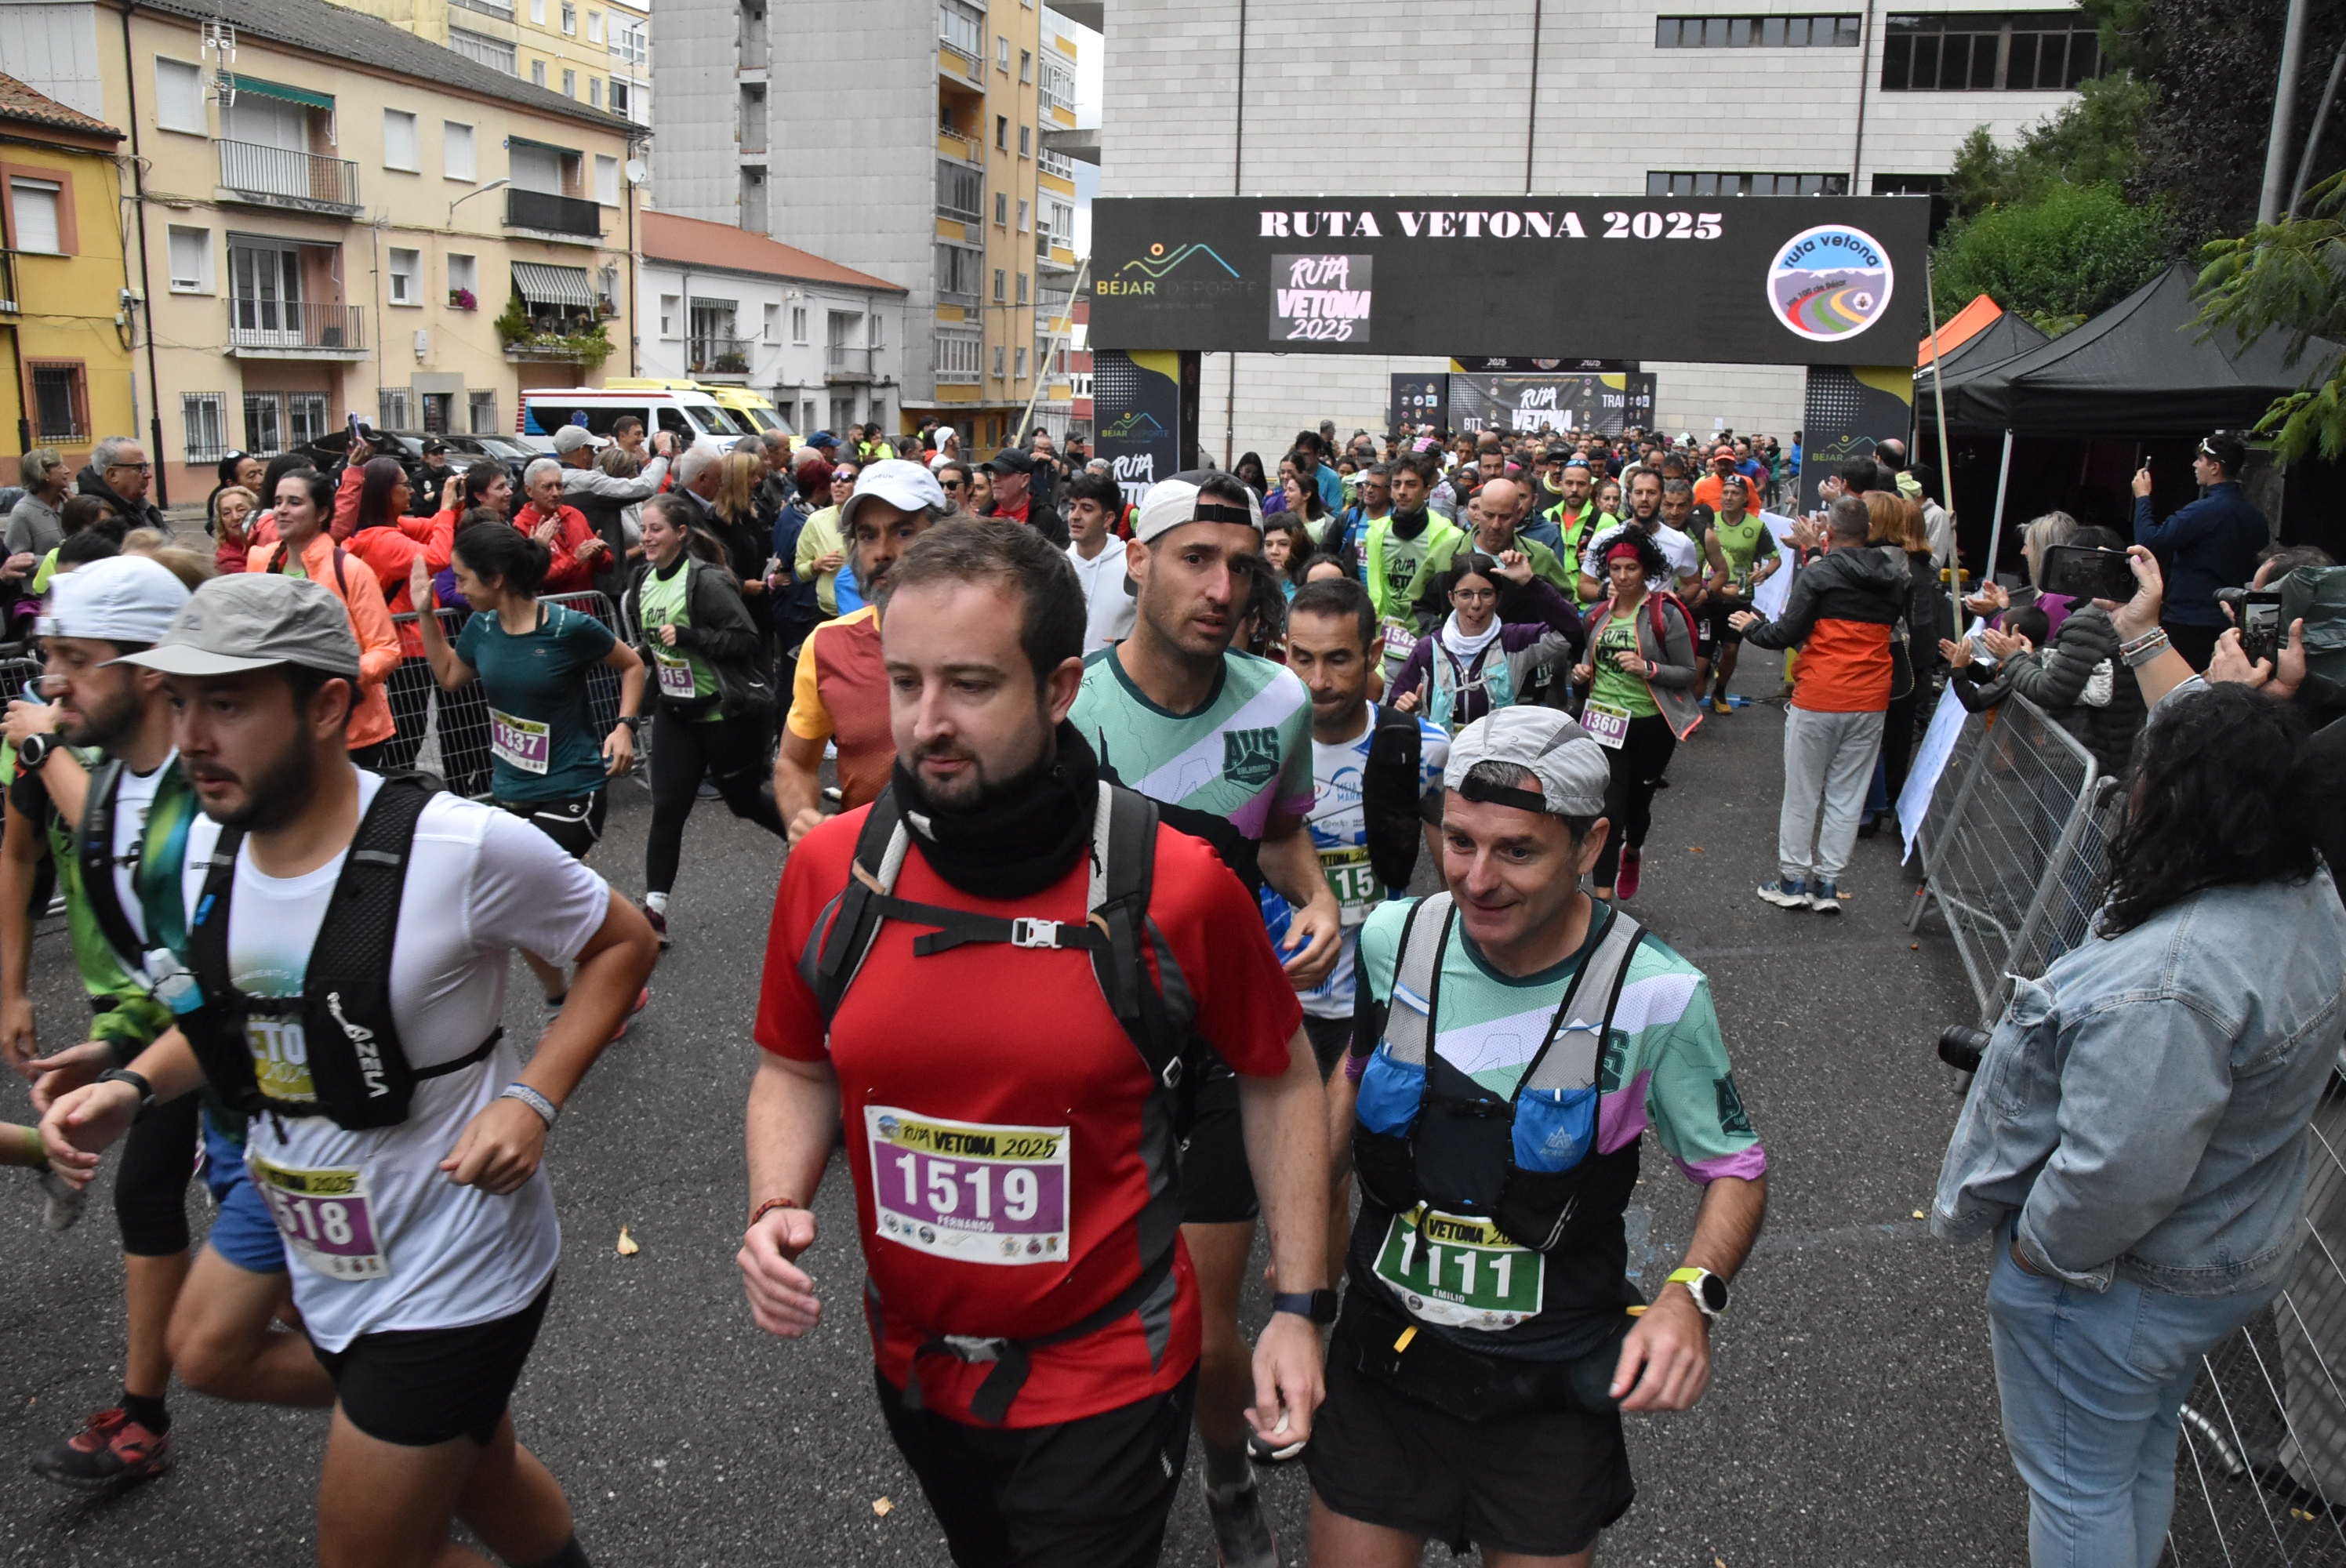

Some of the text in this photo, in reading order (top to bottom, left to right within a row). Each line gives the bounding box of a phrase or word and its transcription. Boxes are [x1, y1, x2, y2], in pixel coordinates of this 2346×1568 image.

[1258, 211, 1723, 239] RUTA VETONA 2025
[1784, 234, 1879, 268] ruta vetona
[1097, 273, 1157, 296] BÉJAR
[1276, 256, 1371, 342] RUTA VETONA 2025
[1520, 386, 1557, 410] RUTA
[1602, 394, 1625, 408] TRAI
[1463, 417, 1483, 431] BTT
[1113, 452, 1154, 482] RUTA
[1385, 626, 1418, 647] 1542
[1585, 711, 1621, 735] 1360
[496, 723, 539, 755] 1337
[903, 1124, 1059, 1159] RUTA VETONA 2025
[895, 1152, 1039, 1221] 1519
[936, 1214, 995, 1233] FERNANDO
[1429, 1218, 1484, 1244] VETONA
[1400, 1230, 1513, 1298] 1111
[1432, 1288, 1465, 1304] EMILIO
